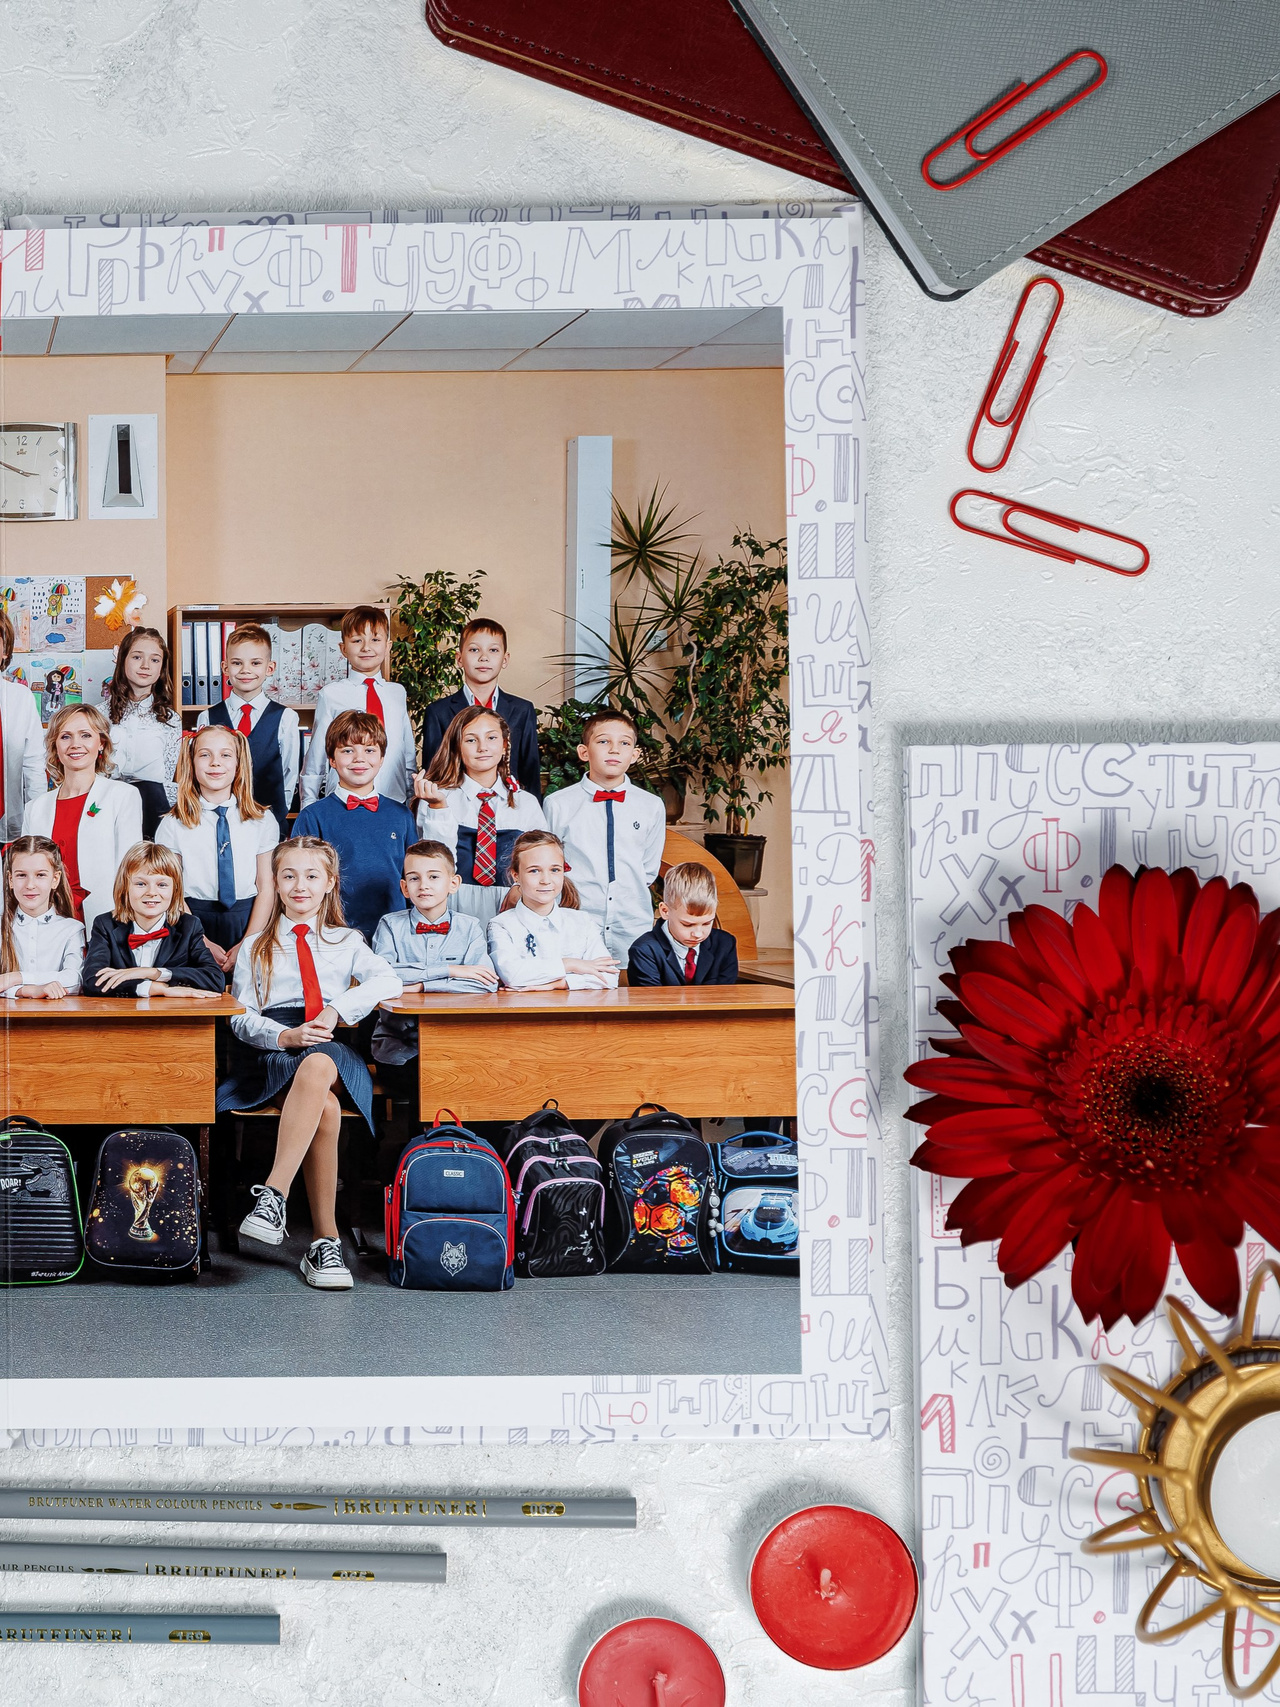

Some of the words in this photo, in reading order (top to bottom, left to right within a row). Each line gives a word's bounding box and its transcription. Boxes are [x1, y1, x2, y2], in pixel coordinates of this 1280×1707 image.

[0, 1178, 21, 1190] ROAR!
[28, 1496, 104, 1508] BRUTFUNER
[108, 1498, 151, 1509] WATER
[156, 1498, 207, 1510] COLOUR
[212, 1499, 263, 1511] PENCILS
[529, 1503, 558, 1516] 062
[24, 1564, 74, 1573] PENCILS
